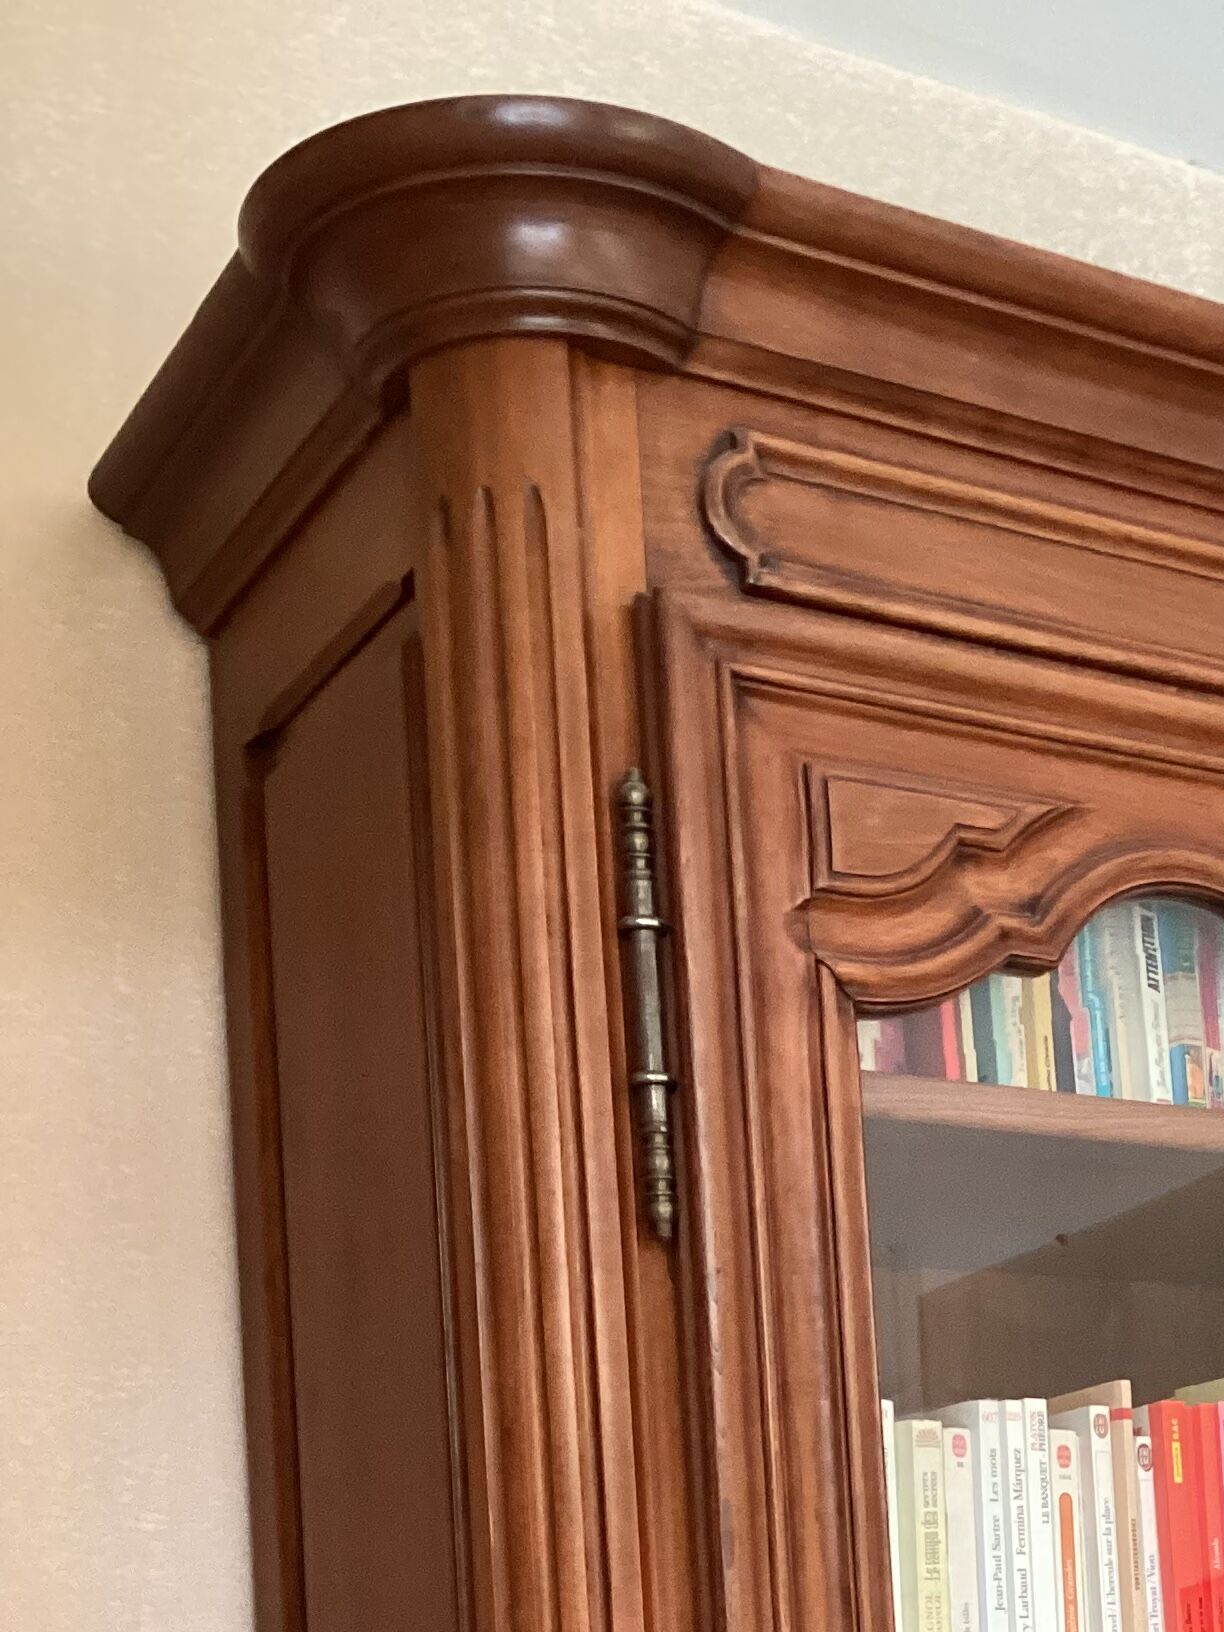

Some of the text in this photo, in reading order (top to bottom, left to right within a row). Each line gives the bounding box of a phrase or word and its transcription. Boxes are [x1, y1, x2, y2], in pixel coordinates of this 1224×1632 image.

[989, 1448, 999, 1503] Les mots
[1039, 1461, 1049, 1509] BANQUET
[1014, 1504, 1026, 1556] Fermina
[1041, 1510, 1050, 1525] LE
[1101, 1497, 1114, 1525] place
[1103, 1526, 1111, 1537] la
[991, 1514, 1006, 1611] Jean-Paul Sartre
[1105, 1540, 1113, 1556] sur
[1016, 1568, 1029, 1619] Larbaud
